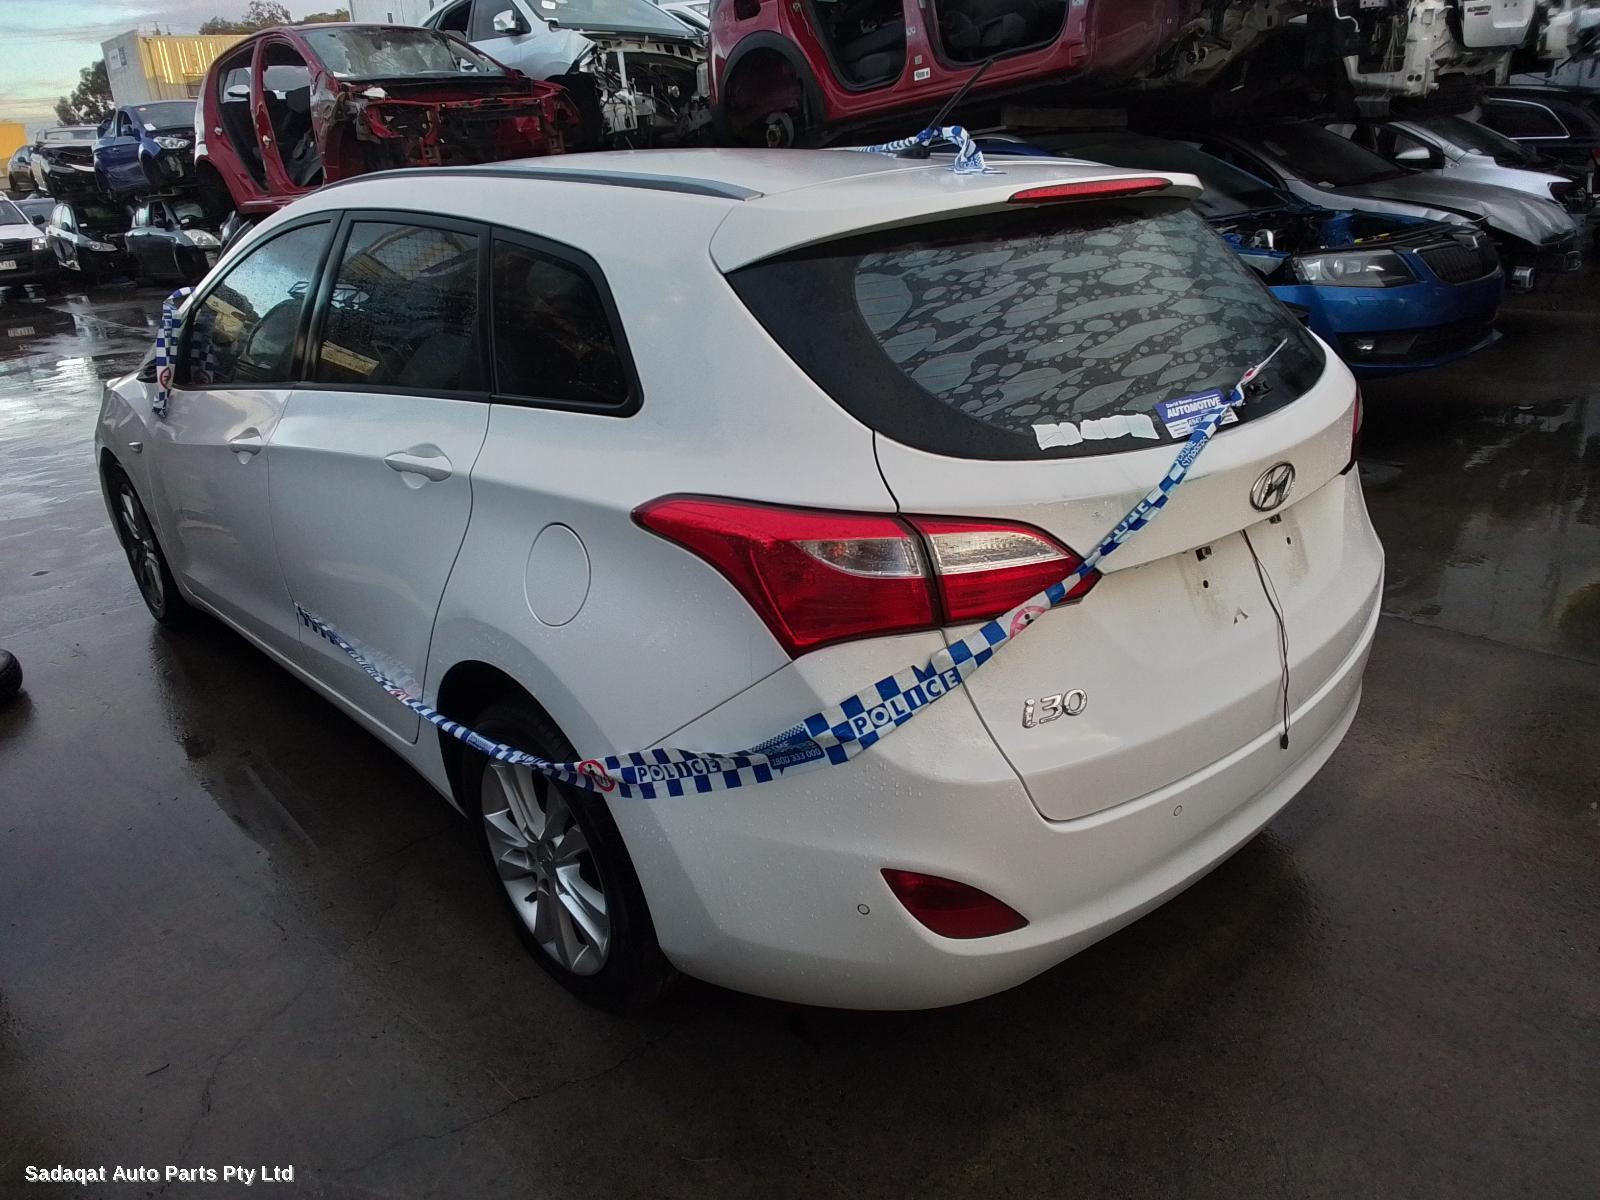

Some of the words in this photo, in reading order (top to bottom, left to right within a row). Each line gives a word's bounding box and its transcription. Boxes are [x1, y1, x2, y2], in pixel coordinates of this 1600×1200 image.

[1167, 396, 1222, 419] AUTOMOTIVE
[852, 669, 960, 735] POLICE
[1022, 689, 1088, 728] i30
[791, 752, 806, 762] 333
[805, 748, 822, 758] 000
[637, 760, 720, 782] POLICE
